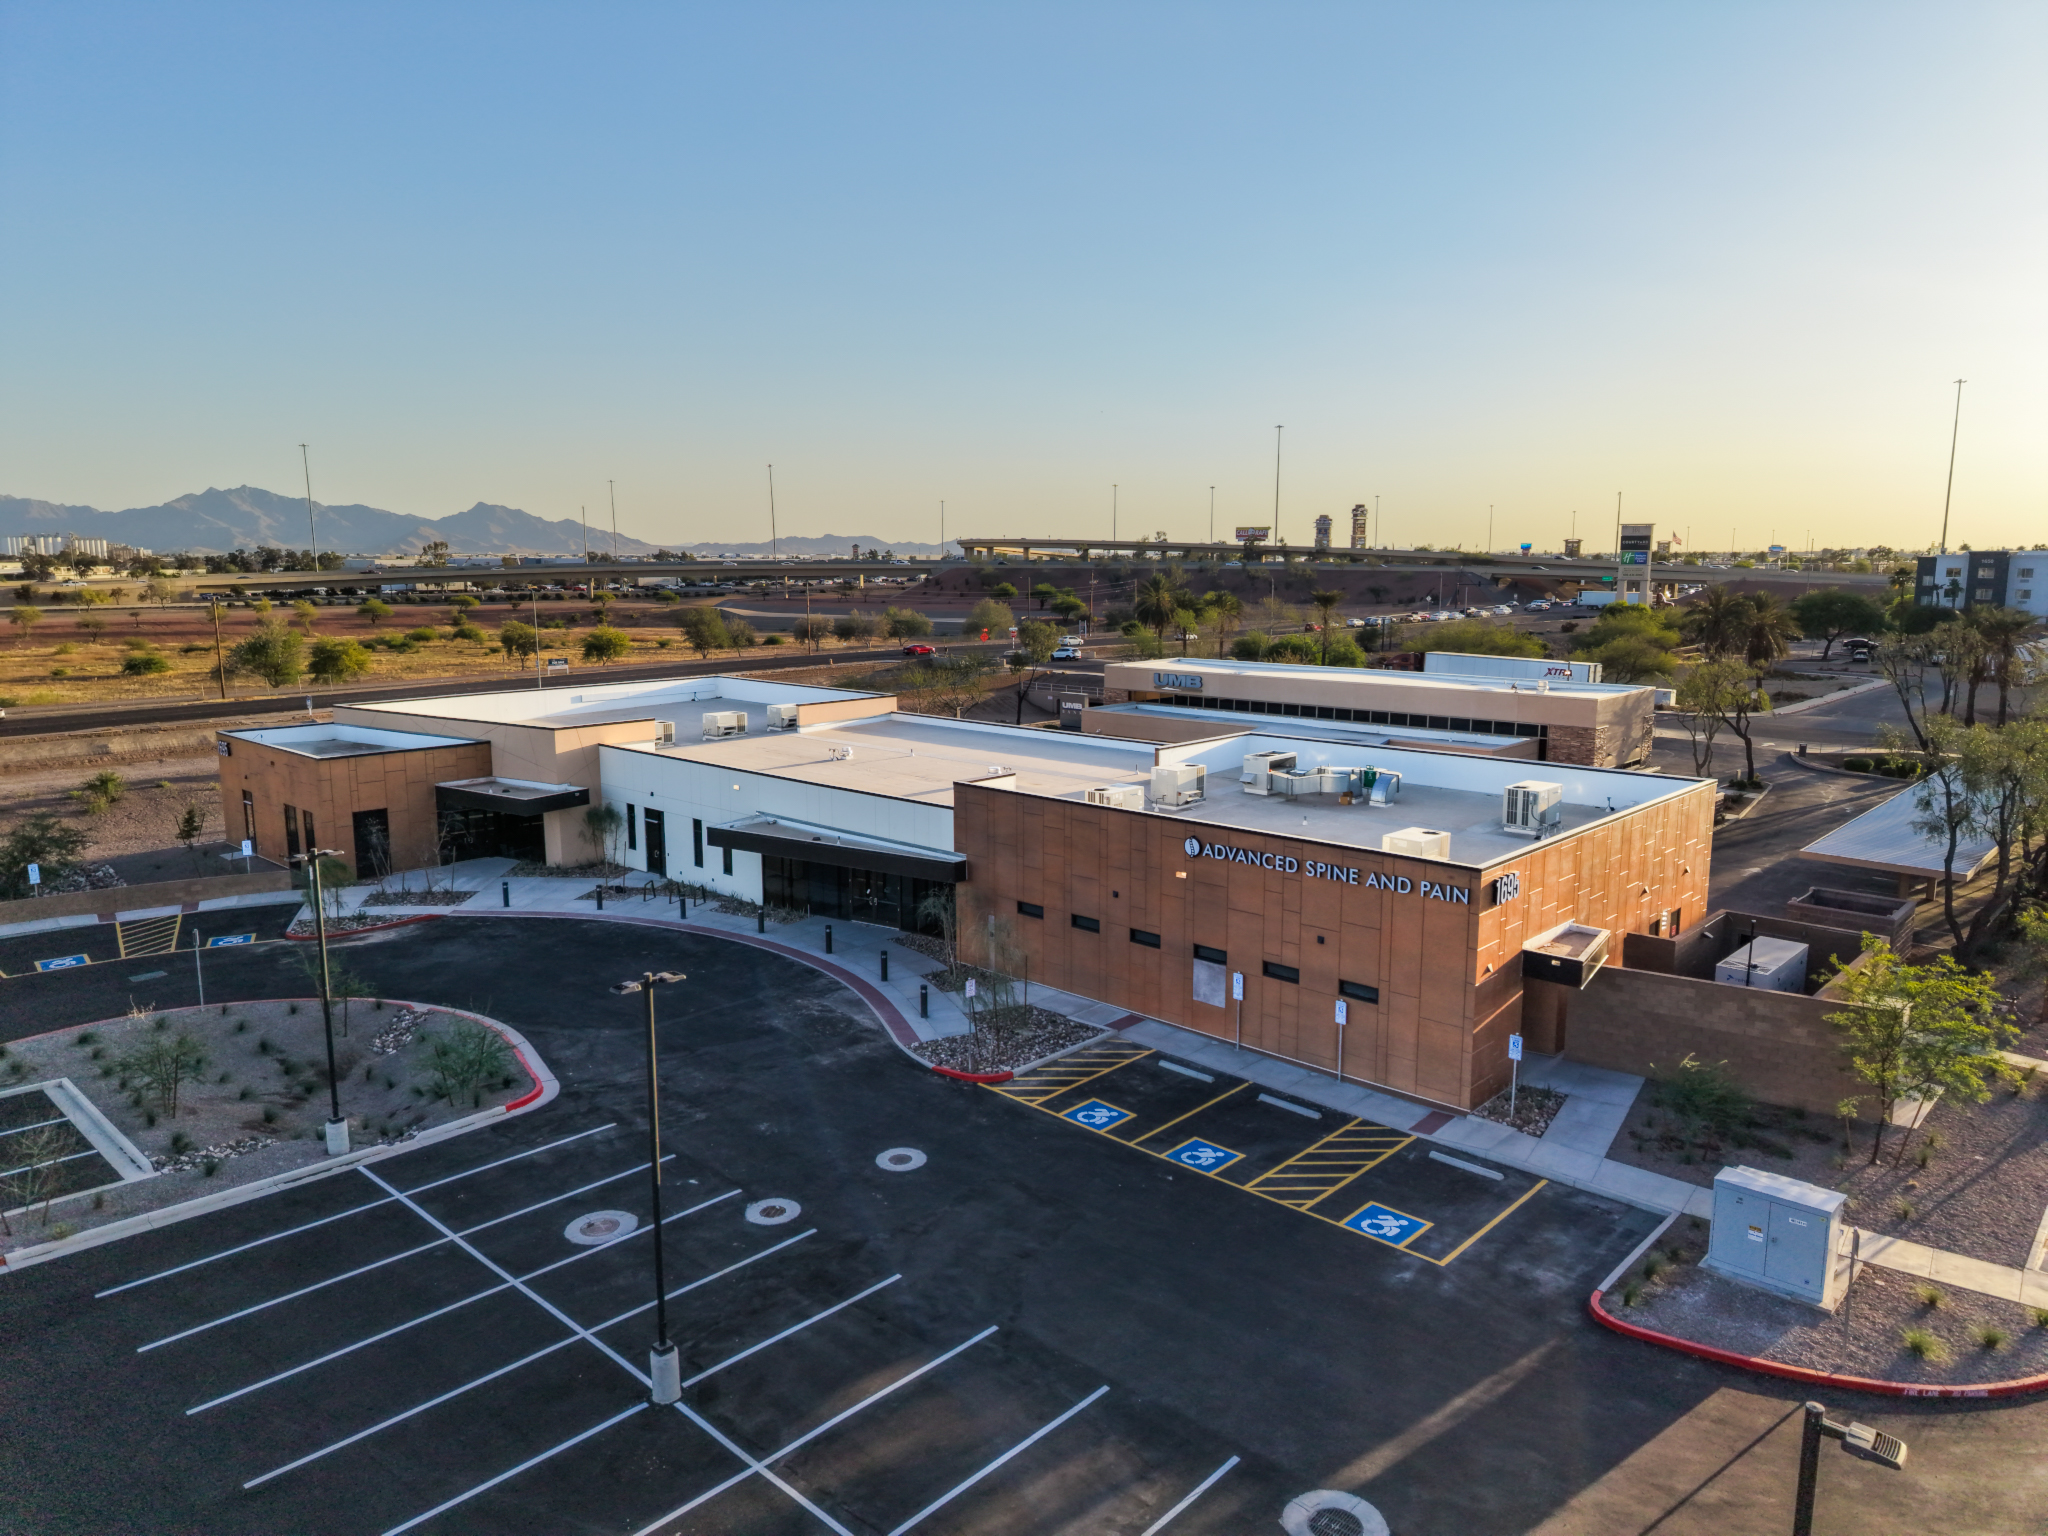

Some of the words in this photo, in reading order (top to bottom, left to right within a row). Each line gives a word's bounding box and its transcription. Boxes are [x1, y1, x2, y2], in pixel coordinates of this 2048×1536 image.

[1153, 672, 1203, 688] UMB
[1202, 843, 1299, 873] ADVANCED
[1305, 860, 1360, 885] SPINE
[1365, 872, 1412, 894] AND
[1420, 880, 1470, 905] PAIN
[1495, 870, 1521, 906] 1695
